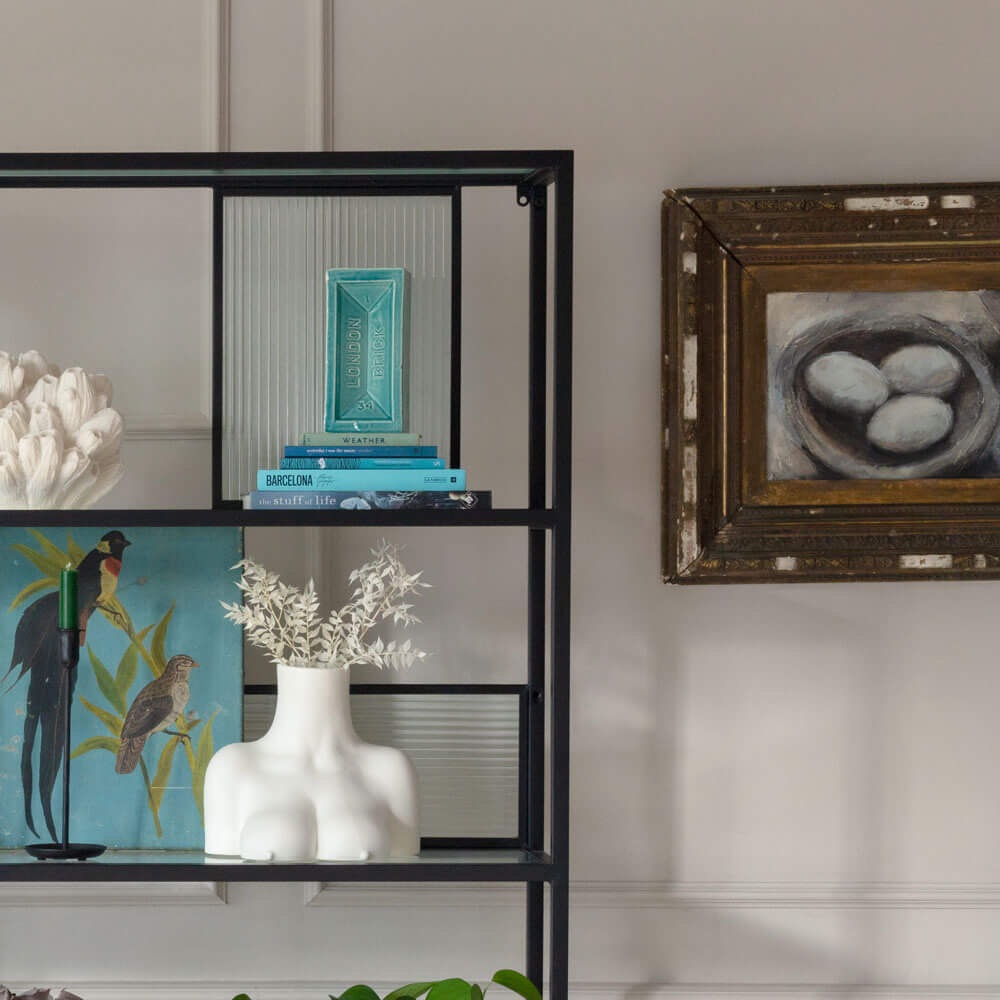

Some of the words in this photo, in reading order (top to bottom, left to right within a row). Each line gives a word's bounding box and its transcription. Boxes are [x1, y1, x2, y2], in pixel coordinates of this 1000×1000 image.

[347, 318, 361, 388] LONDON
[372, 328, 385, 378] BRICK
[266, 474, 313, 487] BARCELONA
[273, 495, 304, 505] stuff
[315, 495, 337, 505] life
